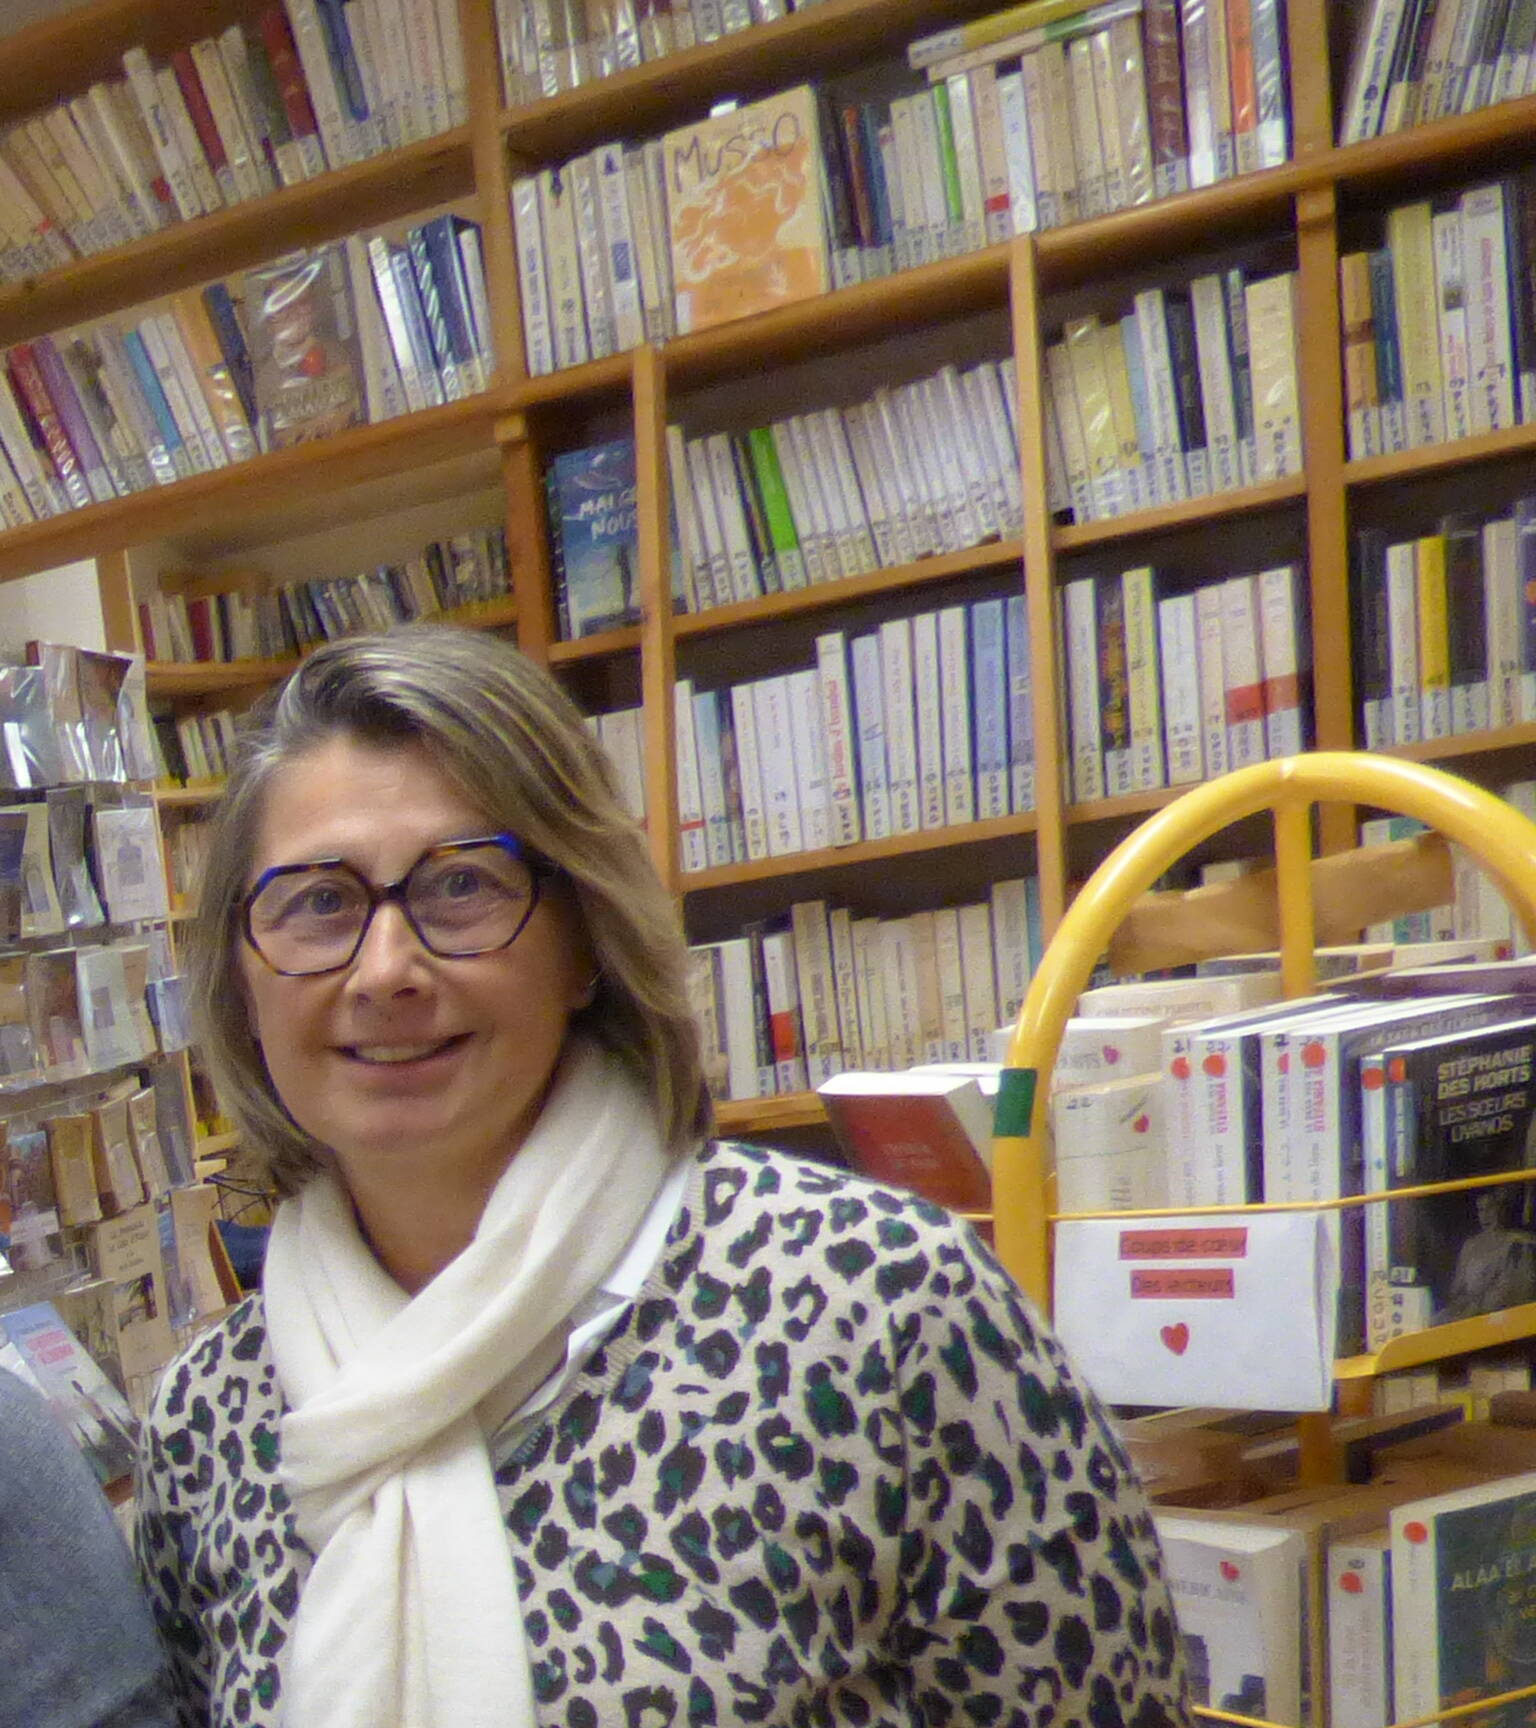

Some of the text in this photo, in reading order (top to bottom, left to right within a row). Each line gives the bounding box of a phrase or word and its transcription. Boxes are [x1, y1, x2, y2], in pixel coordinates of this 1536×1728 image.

[673, 112, 801, 194] MUSSO
[1437, 1079, 1471, 1101] DES
[1439, 1104, 1467, 1127] LES
